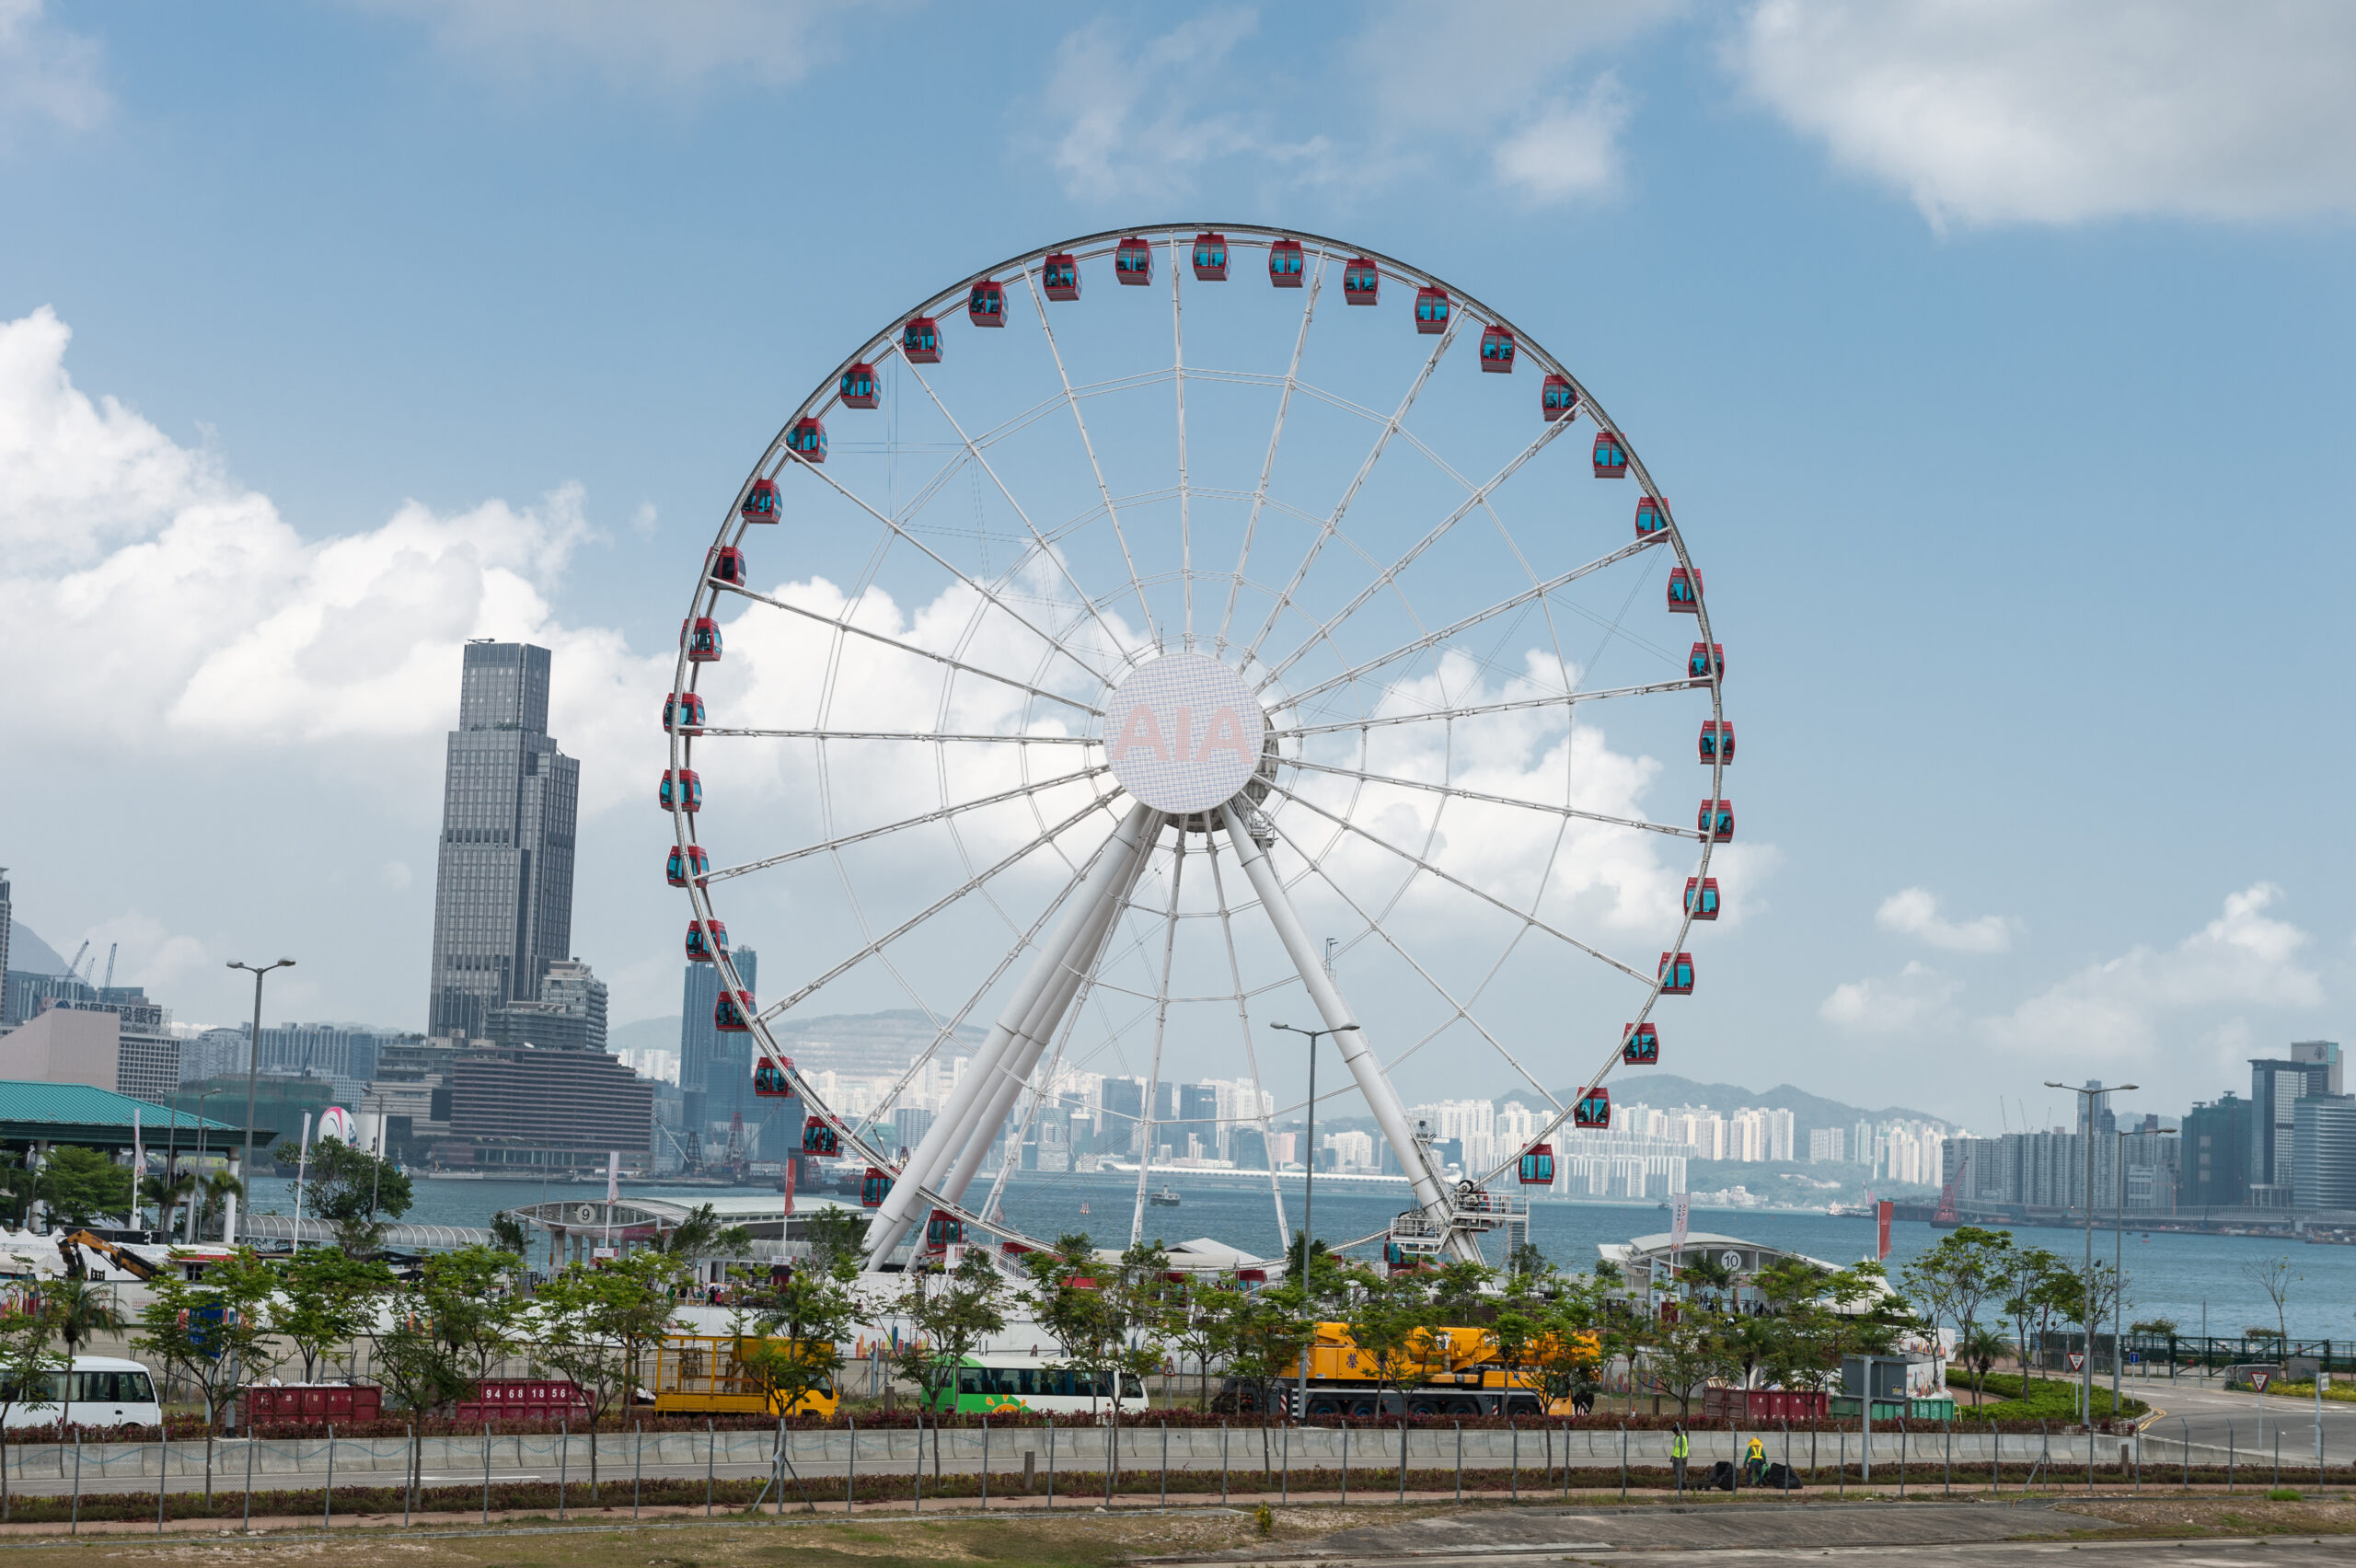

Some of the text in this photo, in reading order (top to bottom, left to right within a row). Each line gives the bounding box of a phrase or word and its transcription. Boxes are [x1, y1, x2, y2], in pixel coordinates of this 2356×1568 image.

[1112, 704, 1253, 763] AIA
[582, 1208, 590, 1220] 9
[1724, 1254, 1738, 1267] 10
[486, 1389, 566, 1399] 94 68 18 56
